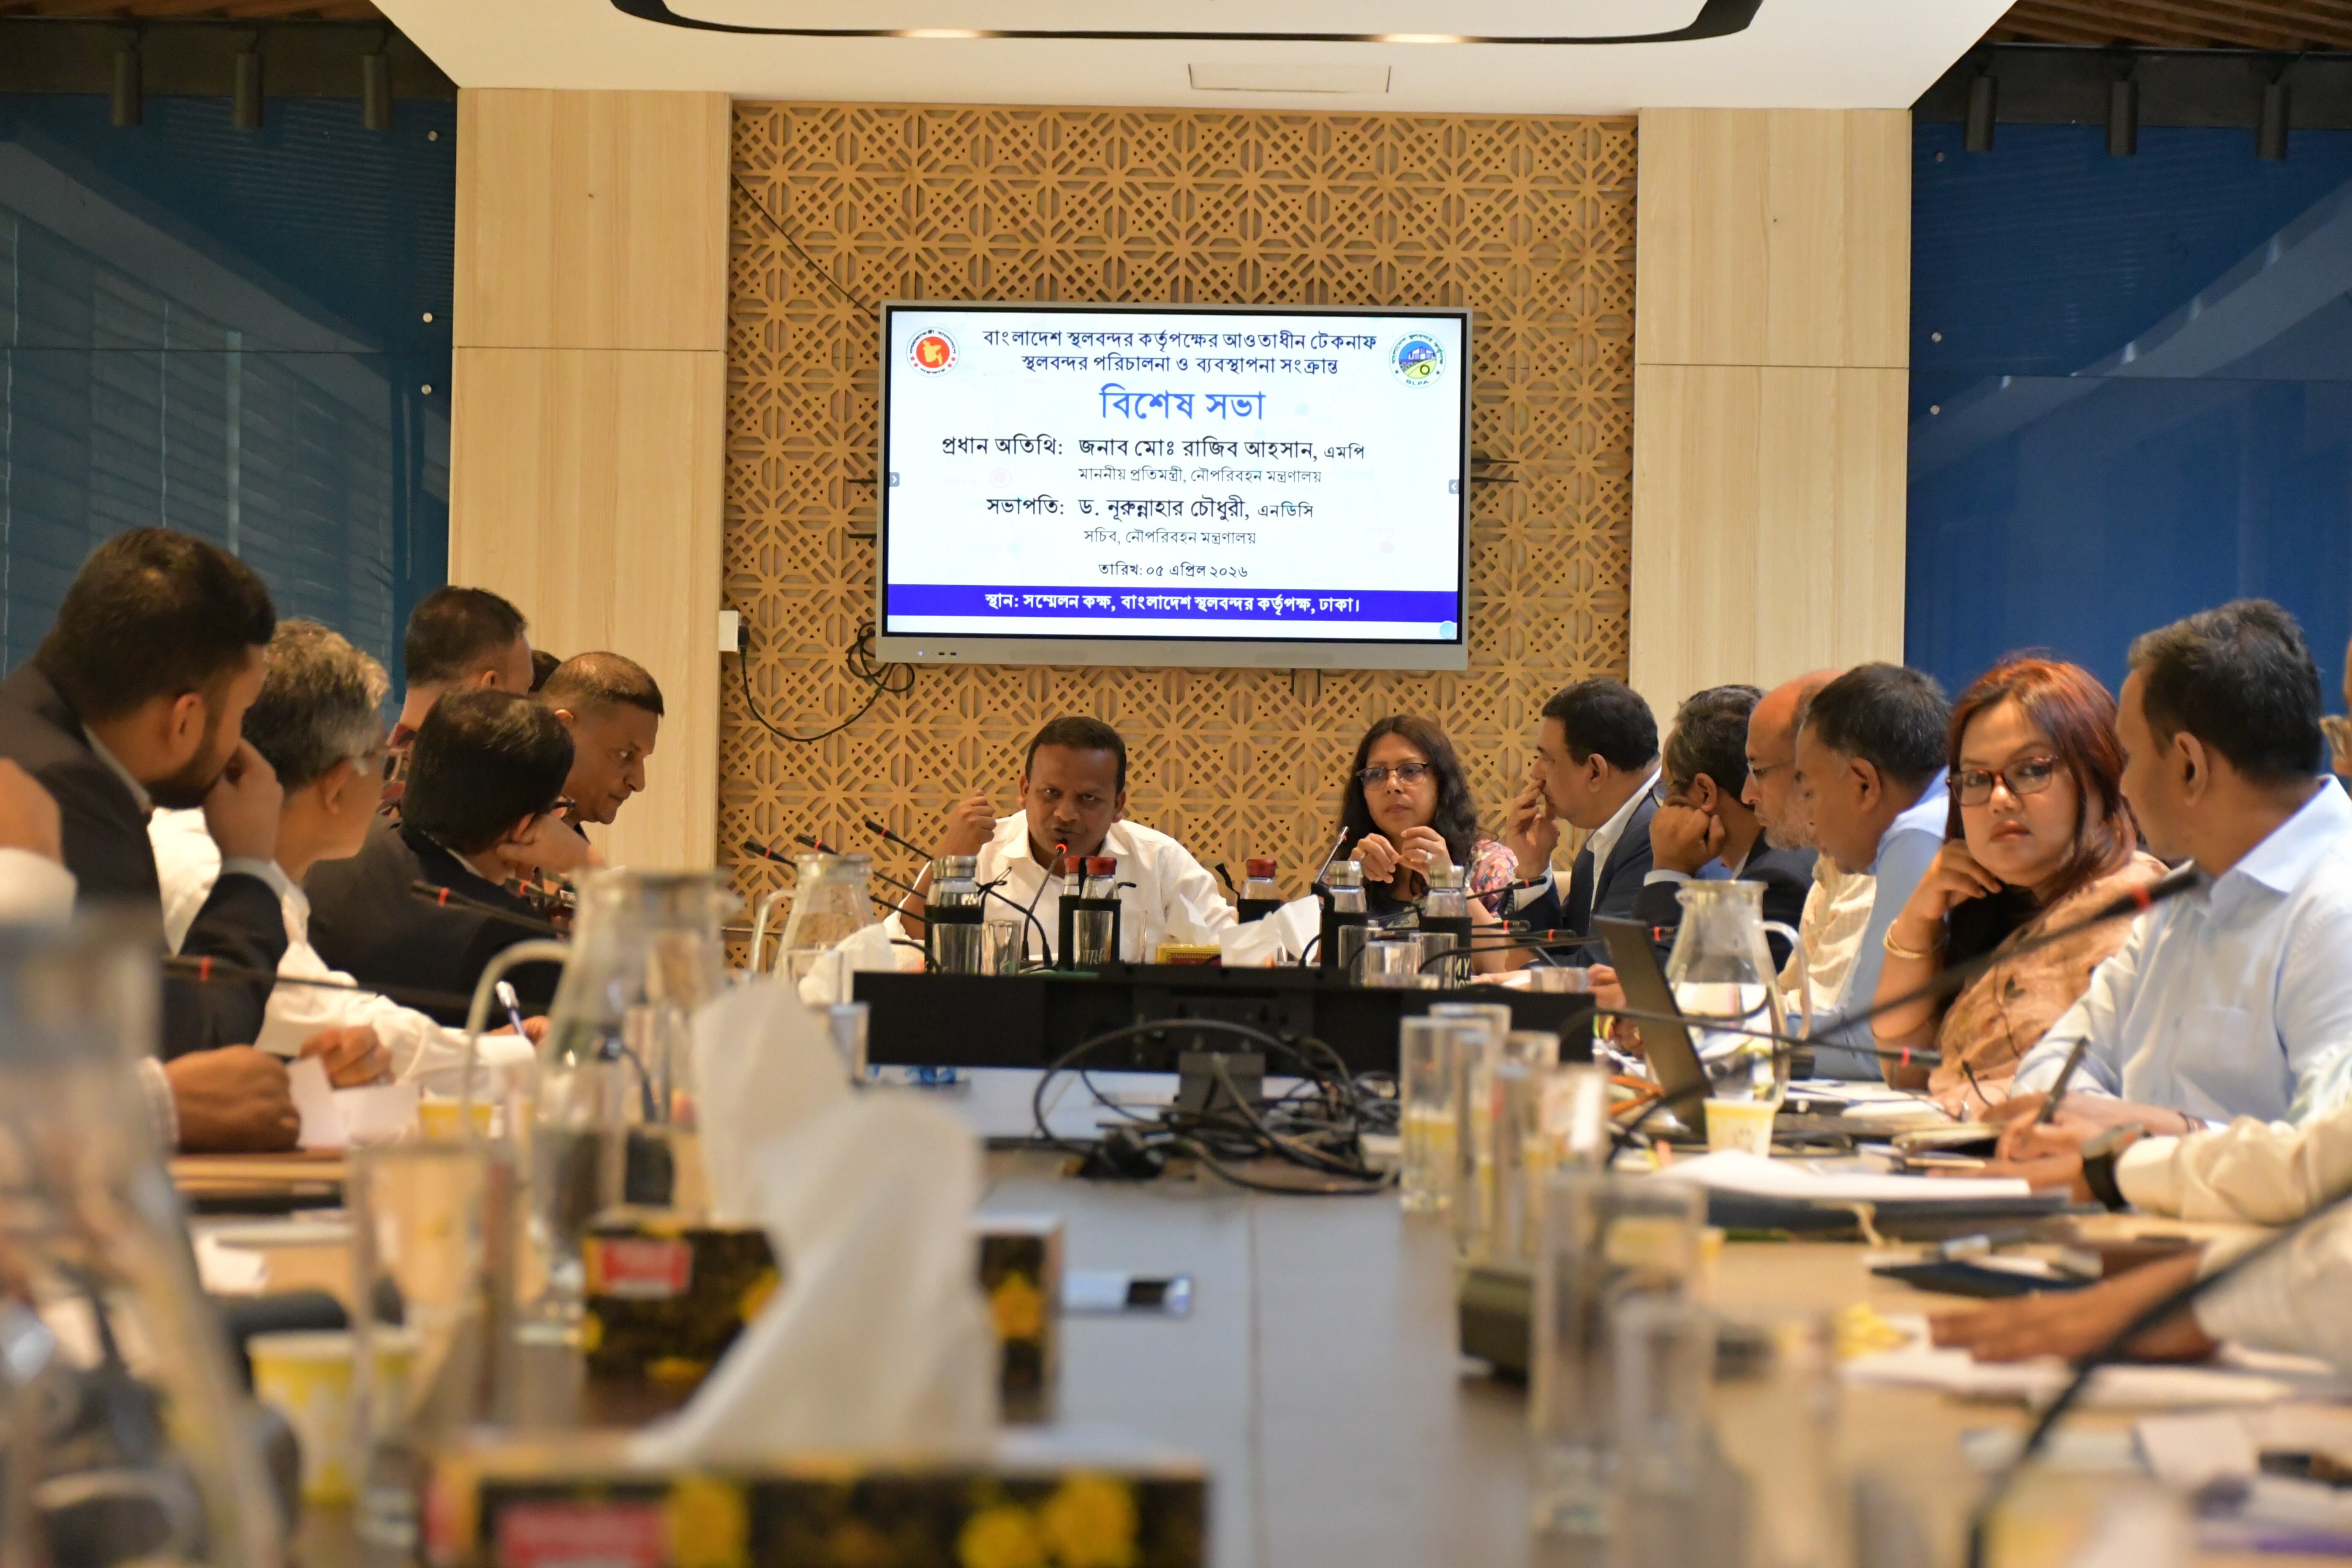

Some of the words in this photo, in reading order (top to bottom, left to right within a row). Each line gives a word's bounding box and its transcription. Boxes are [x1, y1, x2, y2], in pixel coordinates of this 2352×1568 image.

[983, 329, 1062, 347] বাংলাদেশ
[1067, 332, 1134, 348] স্থলবন্দর
[1138, 329, 1219, 352] কর্তৃপক্ষের
[1222, 329, 1306, 349] আওতাধীন
[1310, 330, 1377, 350] টেকনাফ
[1021, 356, 1089, 372] স্থলবন্দর
[1093, 352, 1171, 372] পরিচালনা
[1176, 358, 1188, 371] ও
[1195, 357, 1276, 374] ব্যবস্থাপনা
[1279, 358, 1338, 375] সংক্রান্ত
[1099, 382, 1195, 419] বিশেষ
[1205, 391, 1266, 420] সভা
[942, 436, 989, 455] প্রধান
[994, 433, 1062, 455] অতিথি:
[1078, 438, 1129, 456] জনাব
[1135, 439, 1174, 457] মোঃ
[1181, 436, 1239, 457] রাজিব
[1244, 440, 1318, 462] আহসান,
[1324, 442, 1364, 459] এমপি
[1078, 465, 1125, 480] মাননীয়
[1130, 465, 1186, 483] প্রতিমন্ত্রী,
[1191, 466, 1262, 482] নৌপরিবহন
[1266, 471, 1321, 483] মন্ত্রণালয়
[986, 494, 1064, 515] সভাপতি:
[1078, 499, 1099, 516] ড.
[1106, 499, 1184, 522] নূরুন্নাহার
[1191, 494, 1249, 522] চৌধুরী,
[1258, 501, 1313, 517] এনডিসি
[1084, 527, 1120, 545] সচিব,
[1126, 528, 1197, 544] নৌপরিবহন
[1200, 532, 1256, 544] মন্ত্রণালয়
[1098, 561, 1142, 575] তারিখ:
[1146, 566, 1164, 577] ০৫
[1169, 561, 1206, 577] এপ্রিল
[1210, 566, 1248, 578] ২০২৬
[984, 593, 1018, 610] স্থান:
[1022, 594, 1080, 609] সম্মেলন
[1081, 595, 1116, 612] কক্ষ,
[1120, 594, 1192, 610] বাংলাদেশ
[1193, 596, 1255, 612] স্থলবন্দর
[1256, 593, 1315, 615] কর্তৃপক্ষ,
[1319, 597, 1359, 612] ঢাকা।
